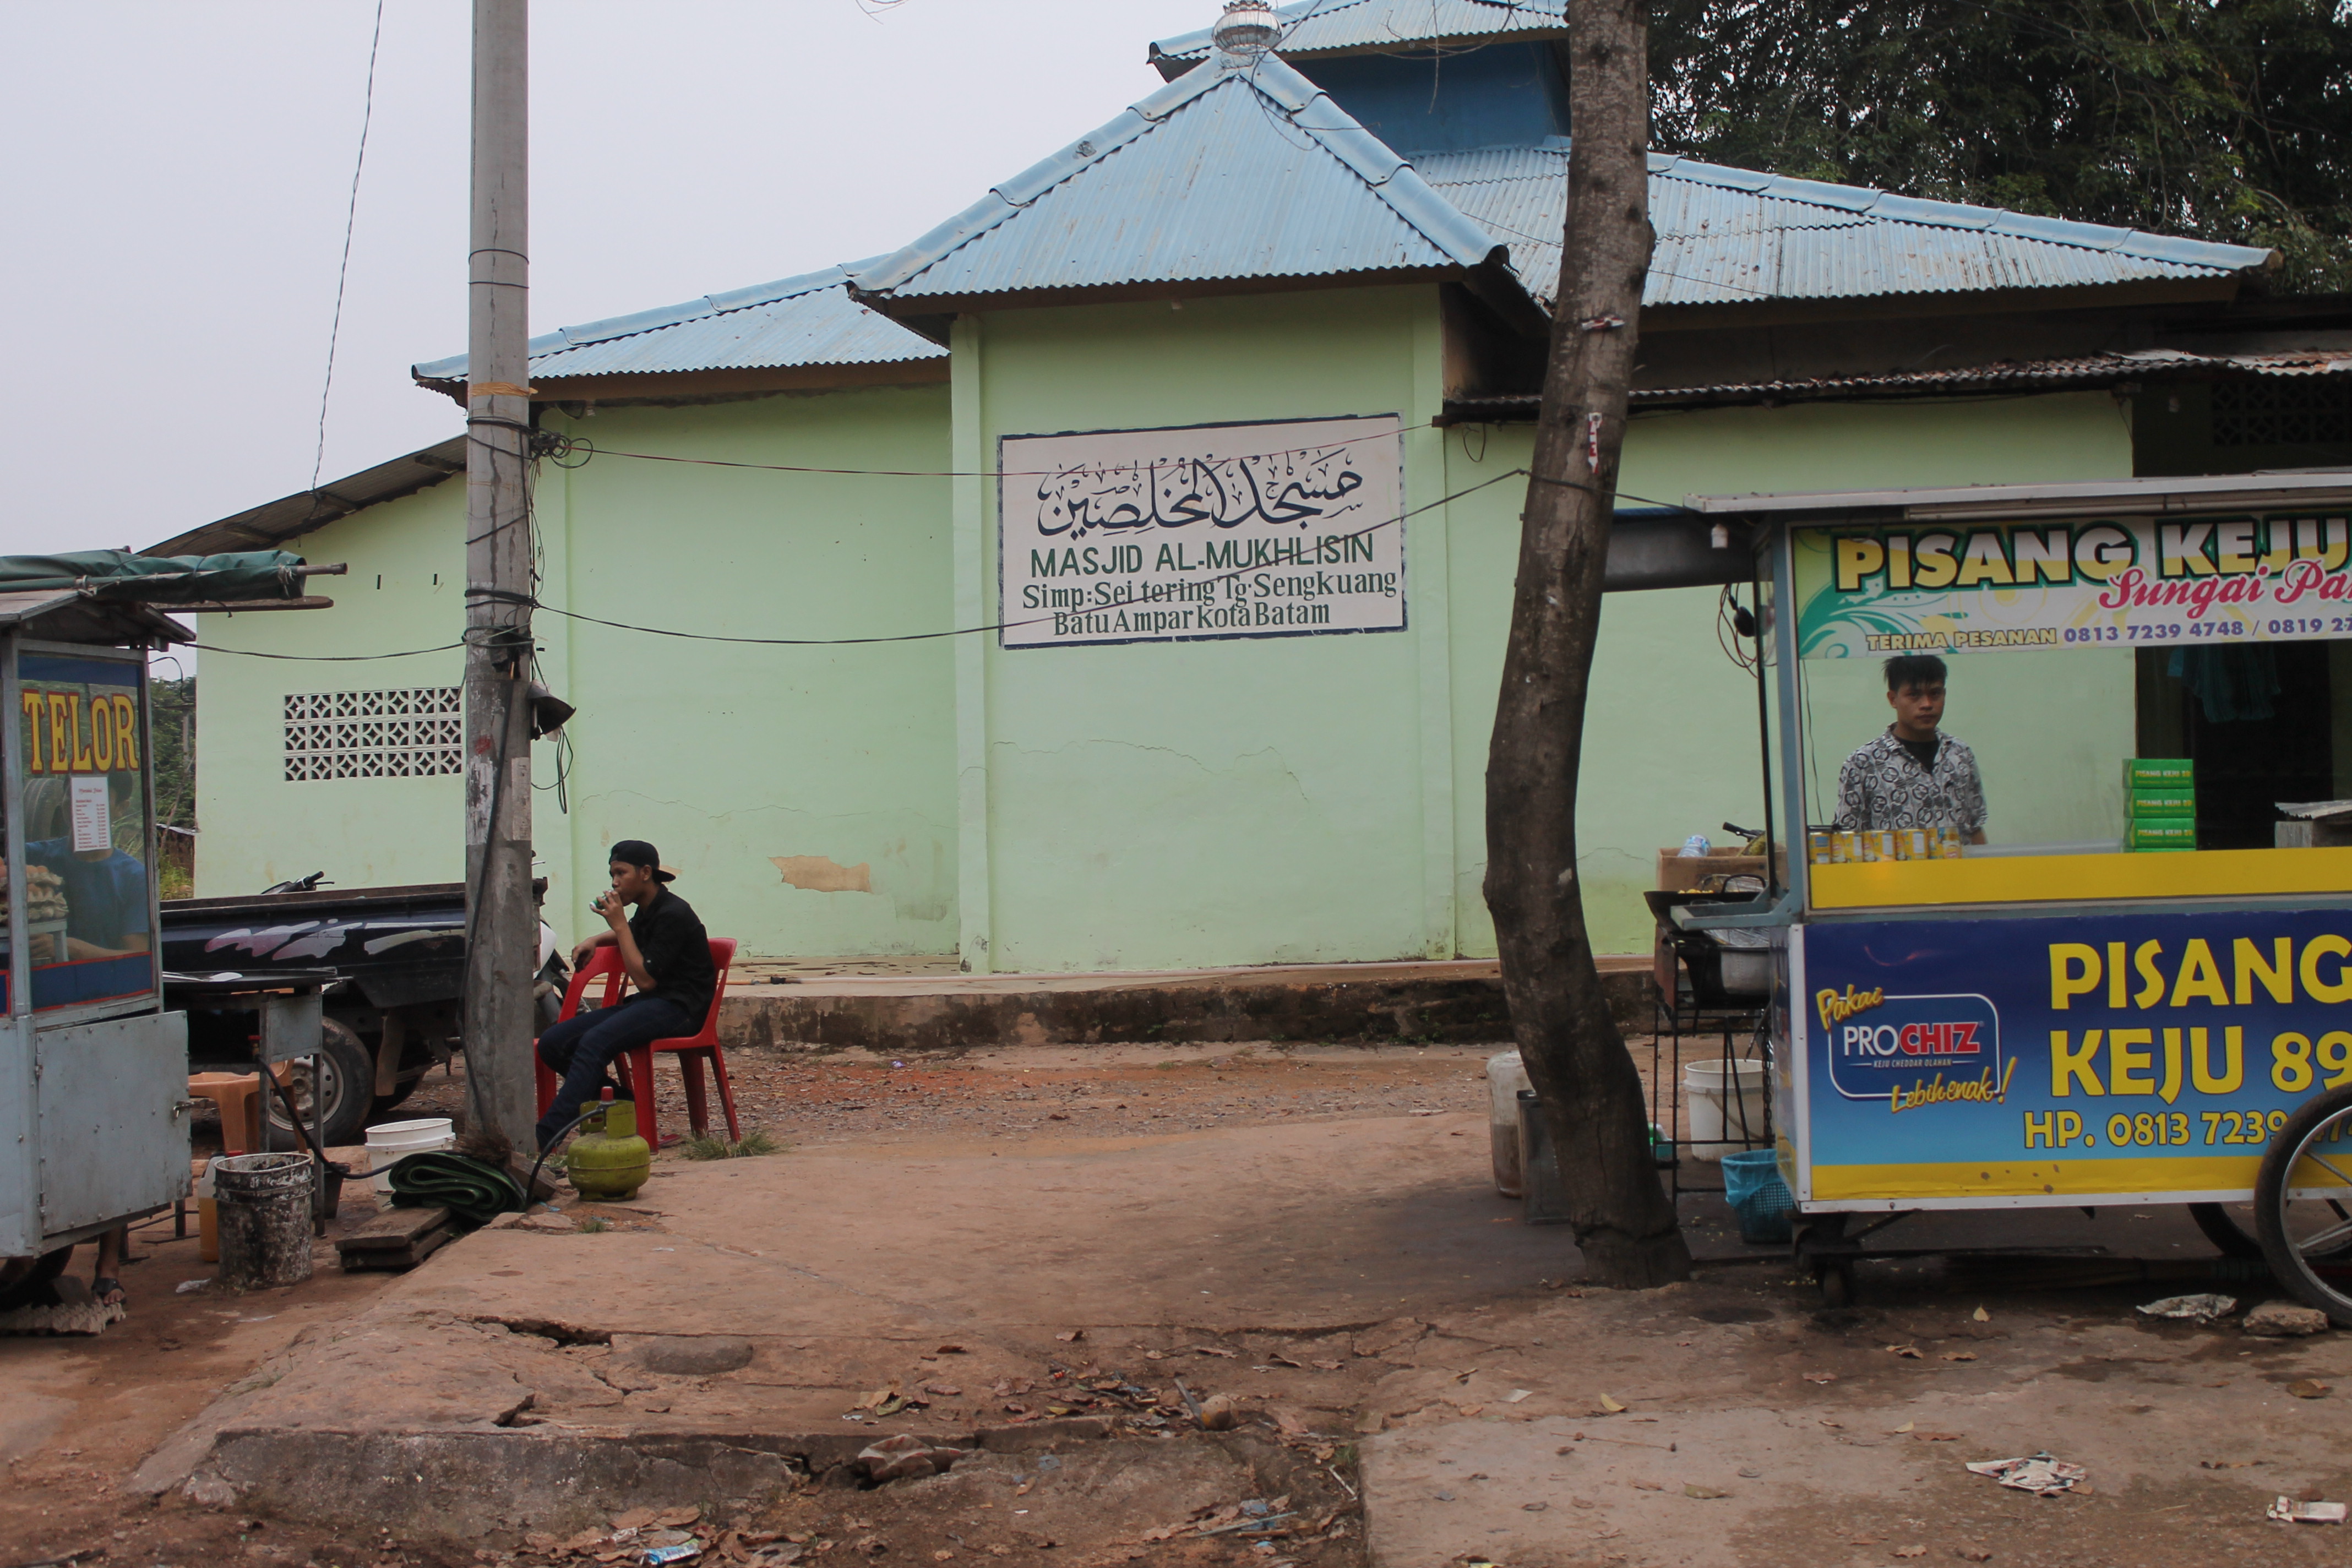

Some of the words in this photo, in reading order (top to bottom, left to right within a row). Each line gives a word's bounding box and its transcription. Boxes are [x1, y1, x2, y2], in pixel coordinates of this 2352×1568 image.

[1031, 545, 1143, 578] MASJID
[1155, 533, 1373, 571] AL-MUKHLISIN
[1836, 524, 2136, 593] PISANG
[2158, 516, 2350, 579] KEJU
[1141, 578, 1215, 606] tering
[2098, 565, 2269, 619] Sungai
[2274, 559, 2352, 604] Pa
[1255, 602, 1330, 626] Batam
[1866, 631, 1950, 651] TERIMA
[1953, 627, 2057, 647] PESANAN
[2064, 624, 2119, 643] 0813
[2127, 623, 2181, 640] 7239
[2189, 620, 2244, 637] 4748
[2268, 618, 2323, 634] 0819
[22, 689, 139, 774] TELOR
[2049, 934, 2352, 1010] PISANG
[1816, 984, 1885, 1032] Pakai
[1843, 1021, 1981, 1056] PROCHIZ
[1891, 1059, 1923, 1068] CHEDDAR
[1924, 1058, 1952, 1066] OLAHAN
[2050, 1026, 2244, 1106] KEJU
[2023, 1110, 2095, 1148] HP.
[2106, 1111, 2190, 1147] 0813
